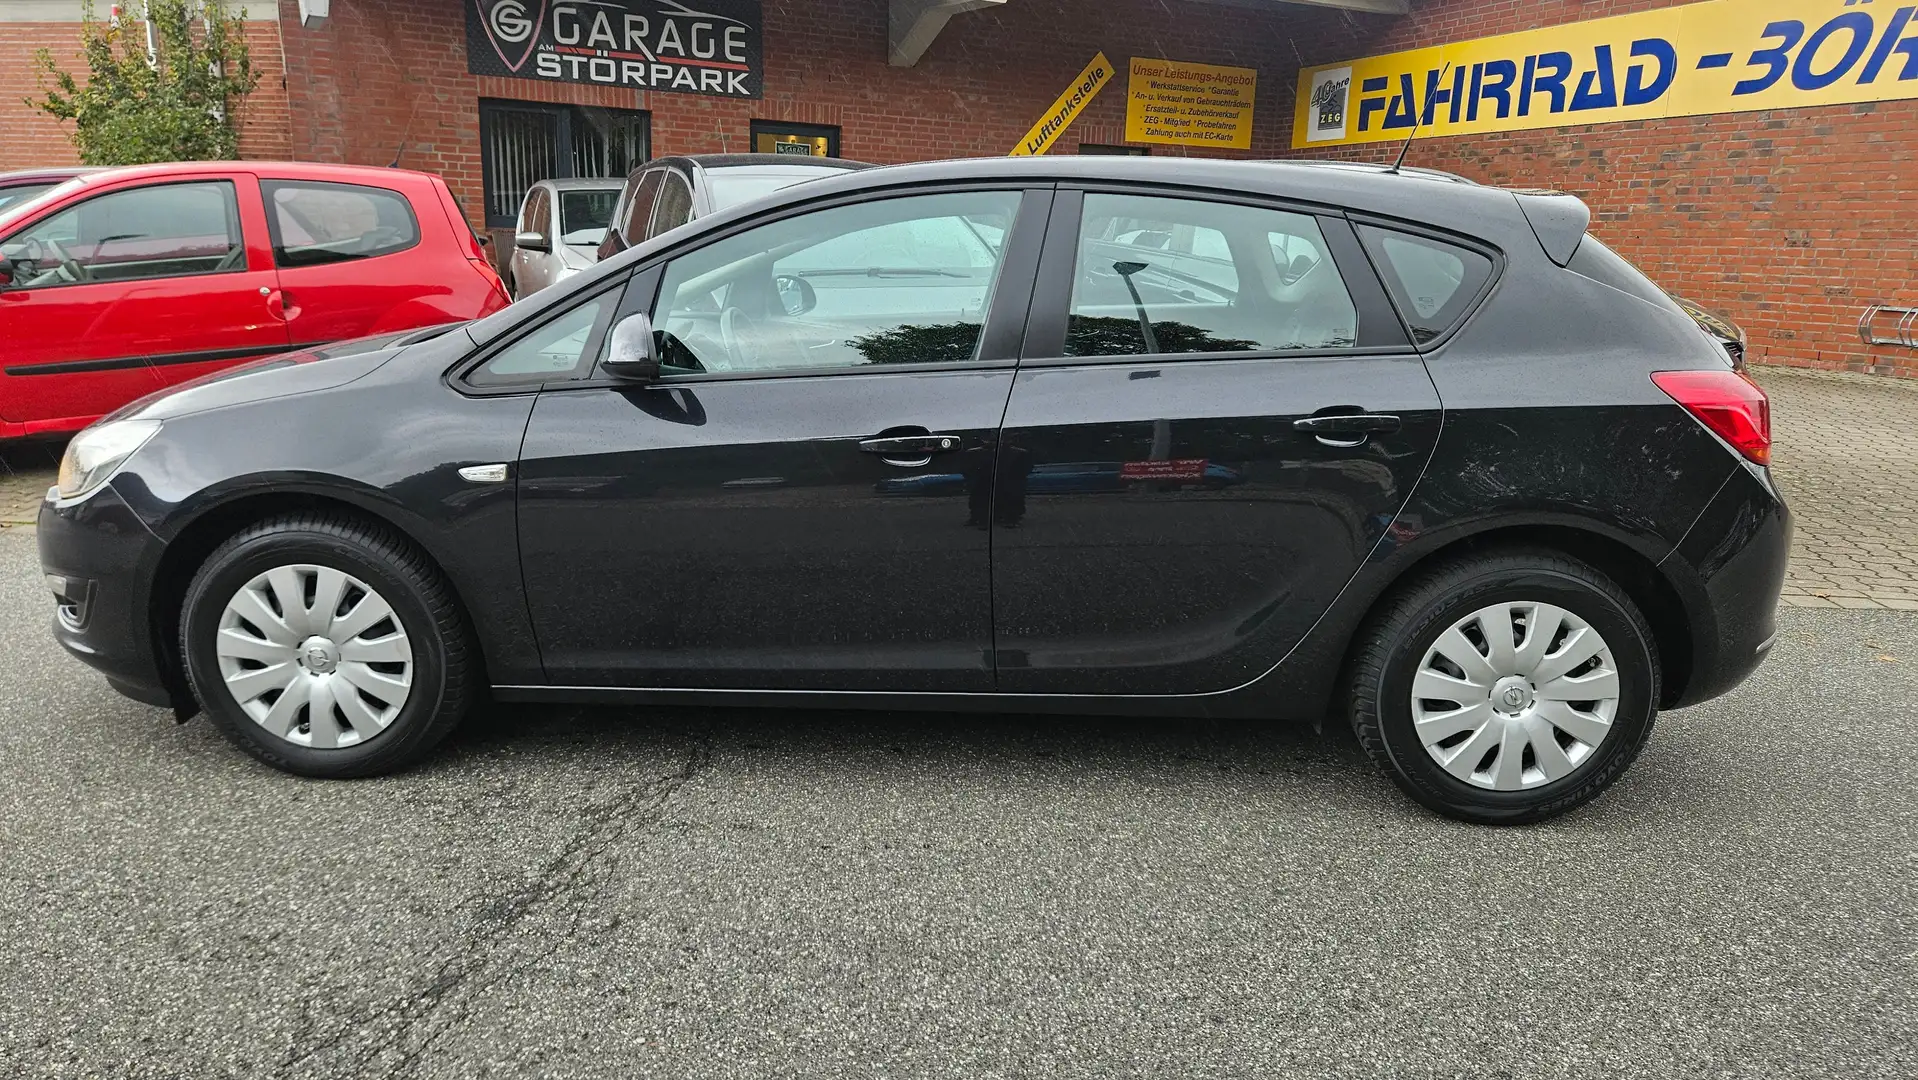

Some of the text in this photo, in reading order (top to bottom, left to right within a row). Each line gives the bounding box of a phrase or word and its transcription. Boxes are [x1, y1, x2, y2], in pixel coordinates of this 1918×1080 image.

[553, 6, 746, 62] GARAGE
[538, 43, 554, 52] AM
[536, 49, 751, 95] STÖRPARK
[1133, 64, 1254, 86] Unser Leistungs-Angebot
[1150, 80, 1240, 97] Werkstattservice Garantie
[1357, 37, 1677, 132] FAHRRAD
[1135, 91, 1148, 99] An-
[1157, 93, 1183, 103] Verkauf
[1182, 96, 1195, 104] von
[1027, 67, 1104, 155] Lufttankstelle
[1145, 104, 1179, 114] Ersatzteil-
[1187, 107, 1240, 119] Zubehörverkauf
[1320, 112, 1341, 124] ZEG
[1143, 115, 1159, 125] ZEG
[1163, 117, 1191, 128] Mitglied
[1196, 119, 1237, 131] Probefahren
[1145, 127, 1234, 142] Zahlung auch mit EC-Karte
